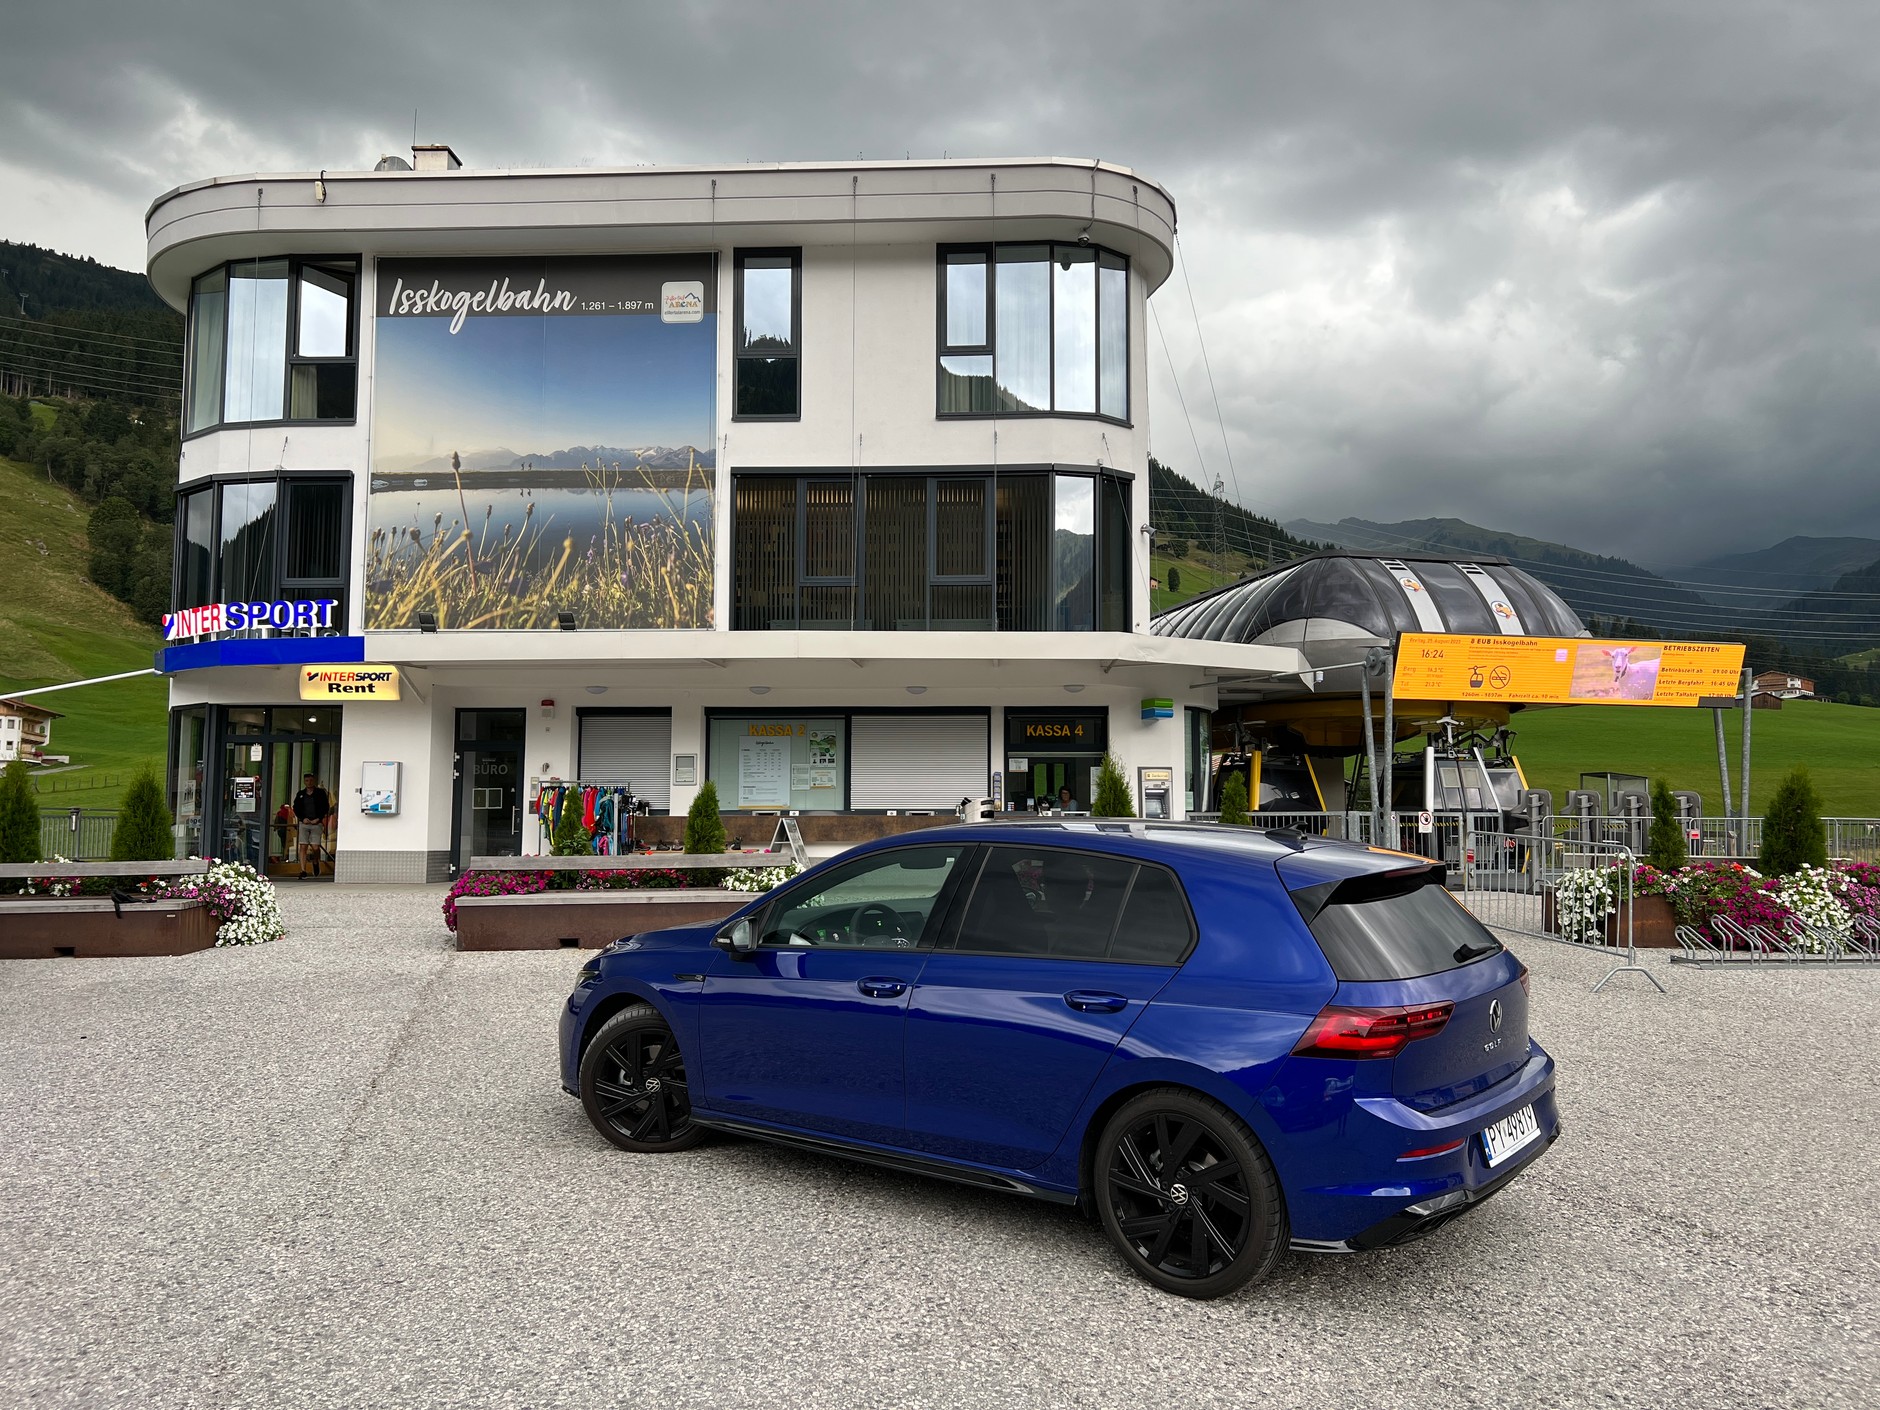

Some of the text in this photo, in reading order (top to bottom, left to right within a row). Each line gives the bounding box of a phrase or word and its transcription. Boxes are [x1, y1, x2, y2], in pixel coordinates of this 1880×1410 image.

[388, 276, 578, 335] Isskogelbahn
[581, 301, 606, 311] 1.261
[617, 301, 643, 310] 1.897
[644, 302, 654, 310] m
[1493, 639, 1538, 647] Isskogelbahn
[1663, 645, 1721, 653] BETRIEBSZEITEN
[1421, 649, 1444, 658] 16:24
[319, 671, 392, 682] INTERSPORT
[327, 682, 376, 694] Rent
[748, 723, 806, 737] KASSA 2
[1026, 724, 1084, 737] KASSA 4
[1483, 1037, 1502, 1052] GOLF
[1488, 1104, 1534, 1154] PY 49819
